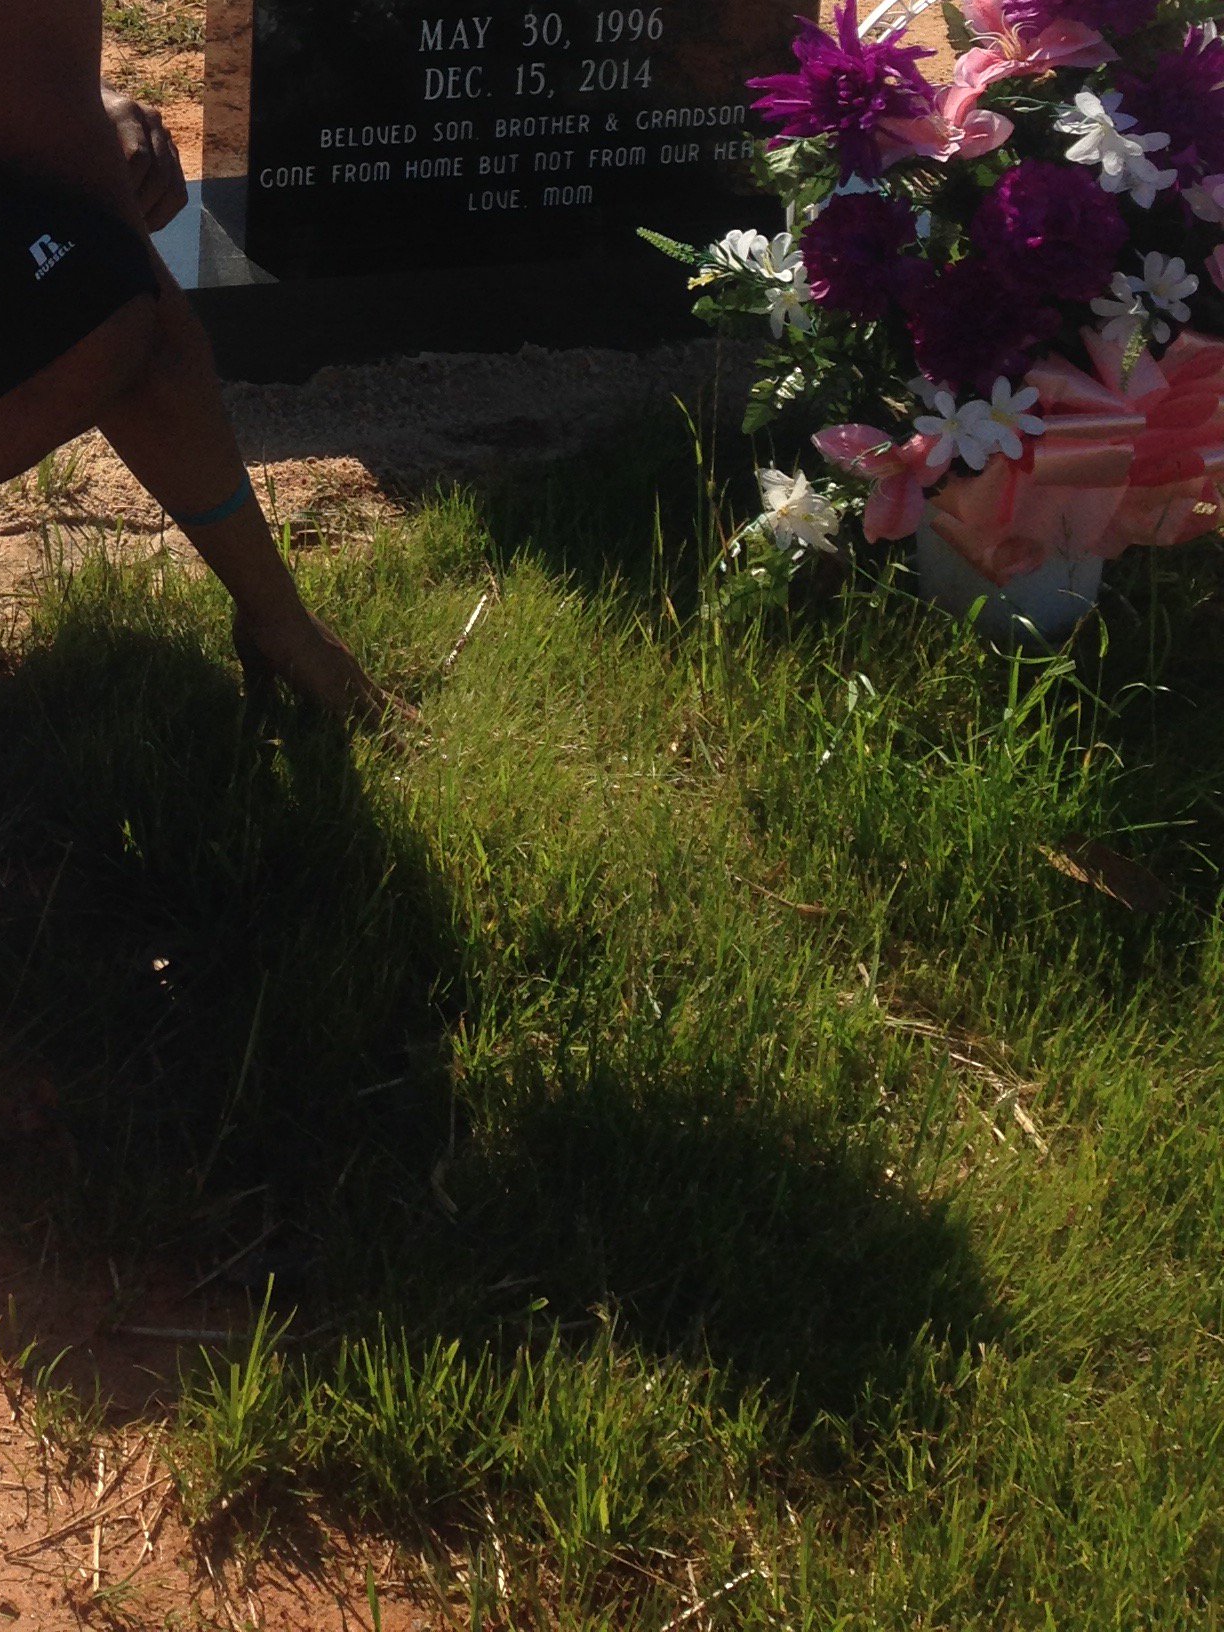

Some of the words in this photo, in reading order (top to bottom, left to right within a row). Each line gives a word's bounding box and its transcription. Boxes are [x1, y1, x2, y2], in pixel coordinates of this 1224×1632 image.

[418, 16, 493, 52] MAY
[521, 12, 573, 50] 30,
[594, 6, 664, 44] 1996
[423, 65, 493, 101] DEC.
[514, 62, 556, 99] 15,
[578, 56, 653, 93] 2014
[320, 123, 418, 149] BELOVED
[494, 113, 591, 139] BROTHER
[604, 111, 620, 133] &
[635, 104, 746, 131] GRANDSON
[259, 165, 317, 189] GONE
[331, 160, 391, 184] FROM
[405, 156, 464, 180] HOME
[478, 153, 520, 175] BUT
[534, 149, 576, 172] NOT
[588, 145, 647, 169] FROM
[659, 142, 701, 165] OUR
[542, 184, 594, 207] MOM
